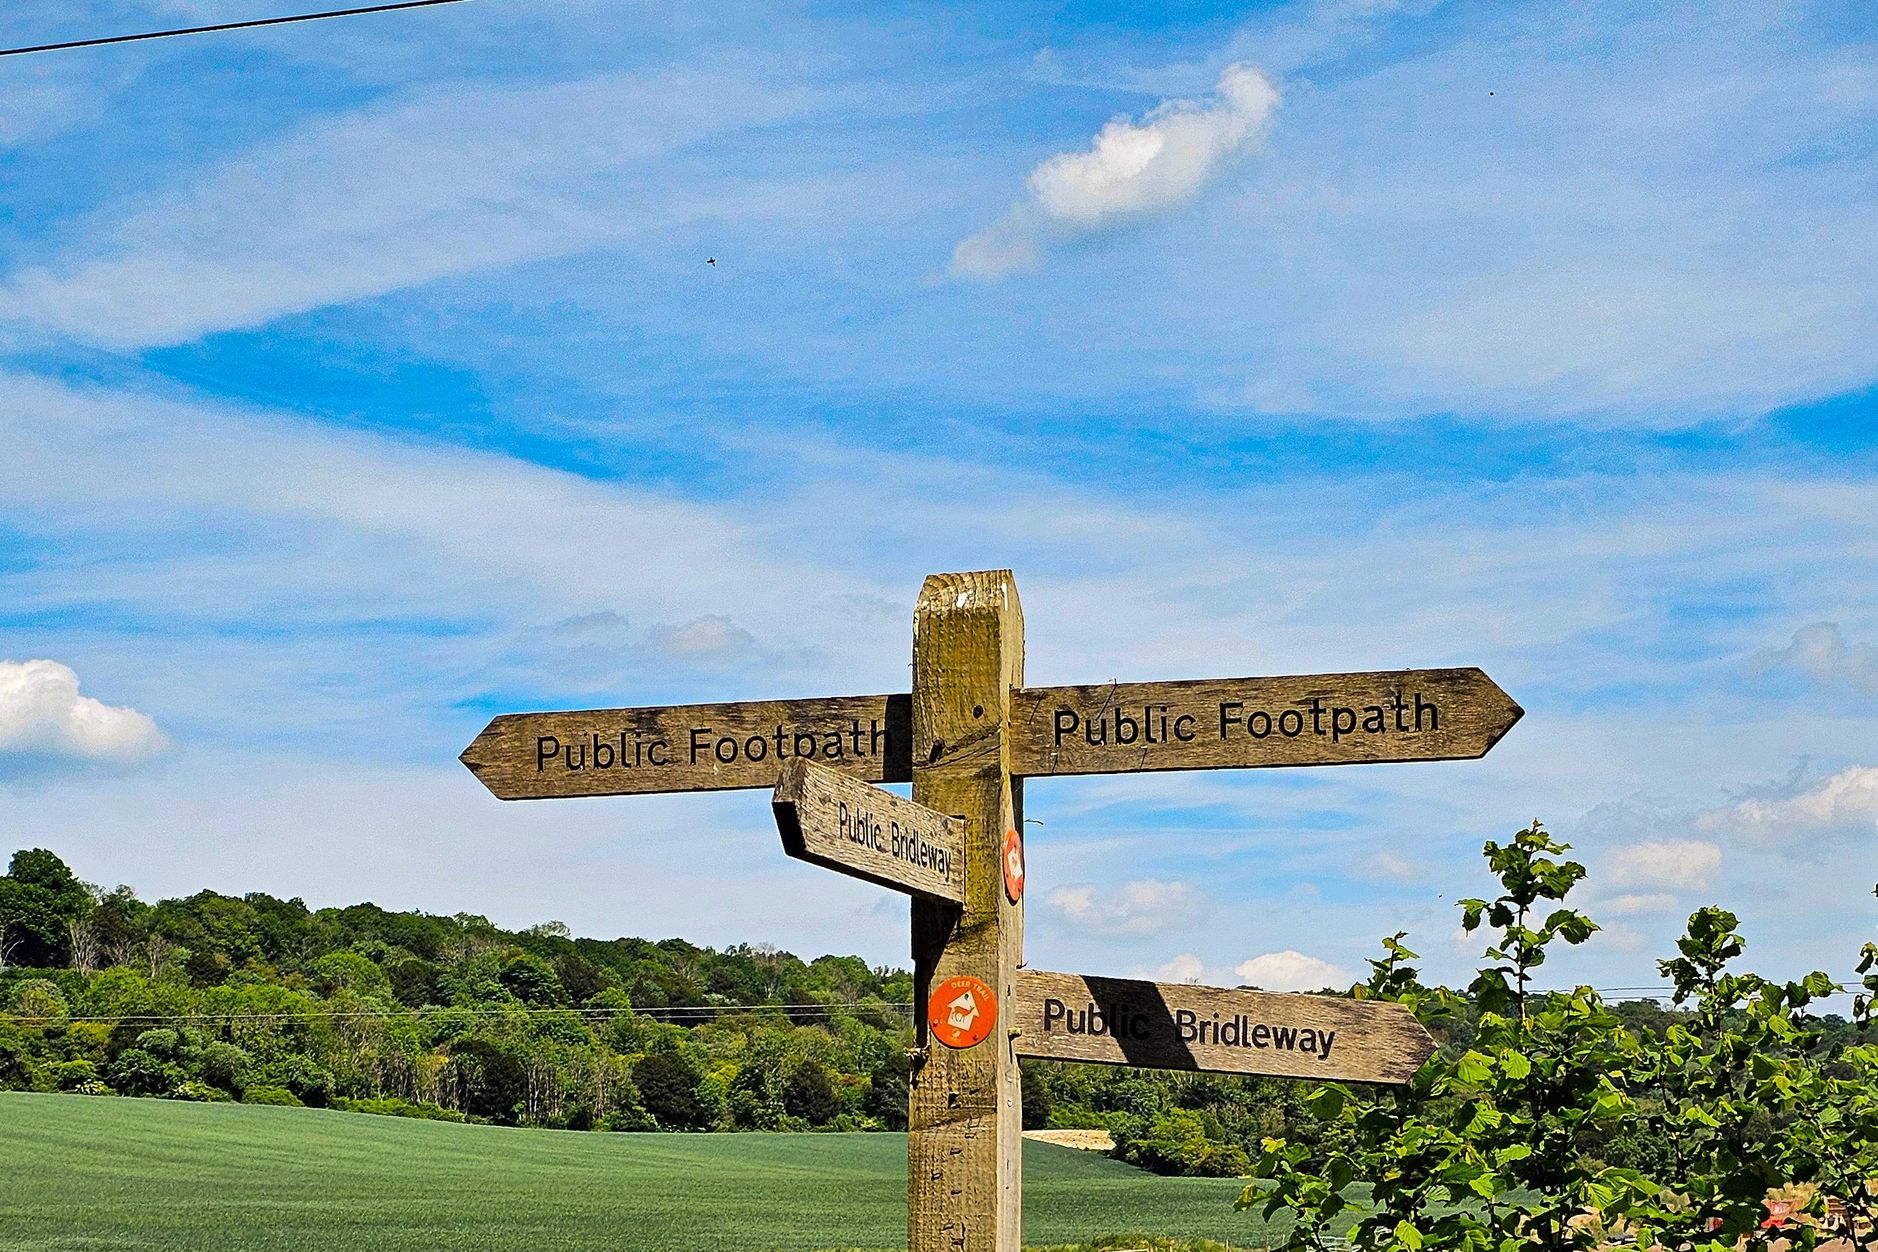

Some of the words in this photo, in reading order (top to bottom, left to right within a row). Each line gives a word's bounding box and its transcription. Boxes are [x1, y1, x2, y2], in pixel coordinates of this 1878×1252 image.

[536, 733, 669, 772] Public
[689, 719, 893, 765] Footpath
[1053, 706, 1196, 747] Public
[1219, 692, 1439, 743] Footpath
[839, 801, 882, 850] Public
[891, 821, 951, 882] Bridleway
[1043, 998, 1150, 1040] Public
[1175, 1009, 1335, 1060] Bridleway
